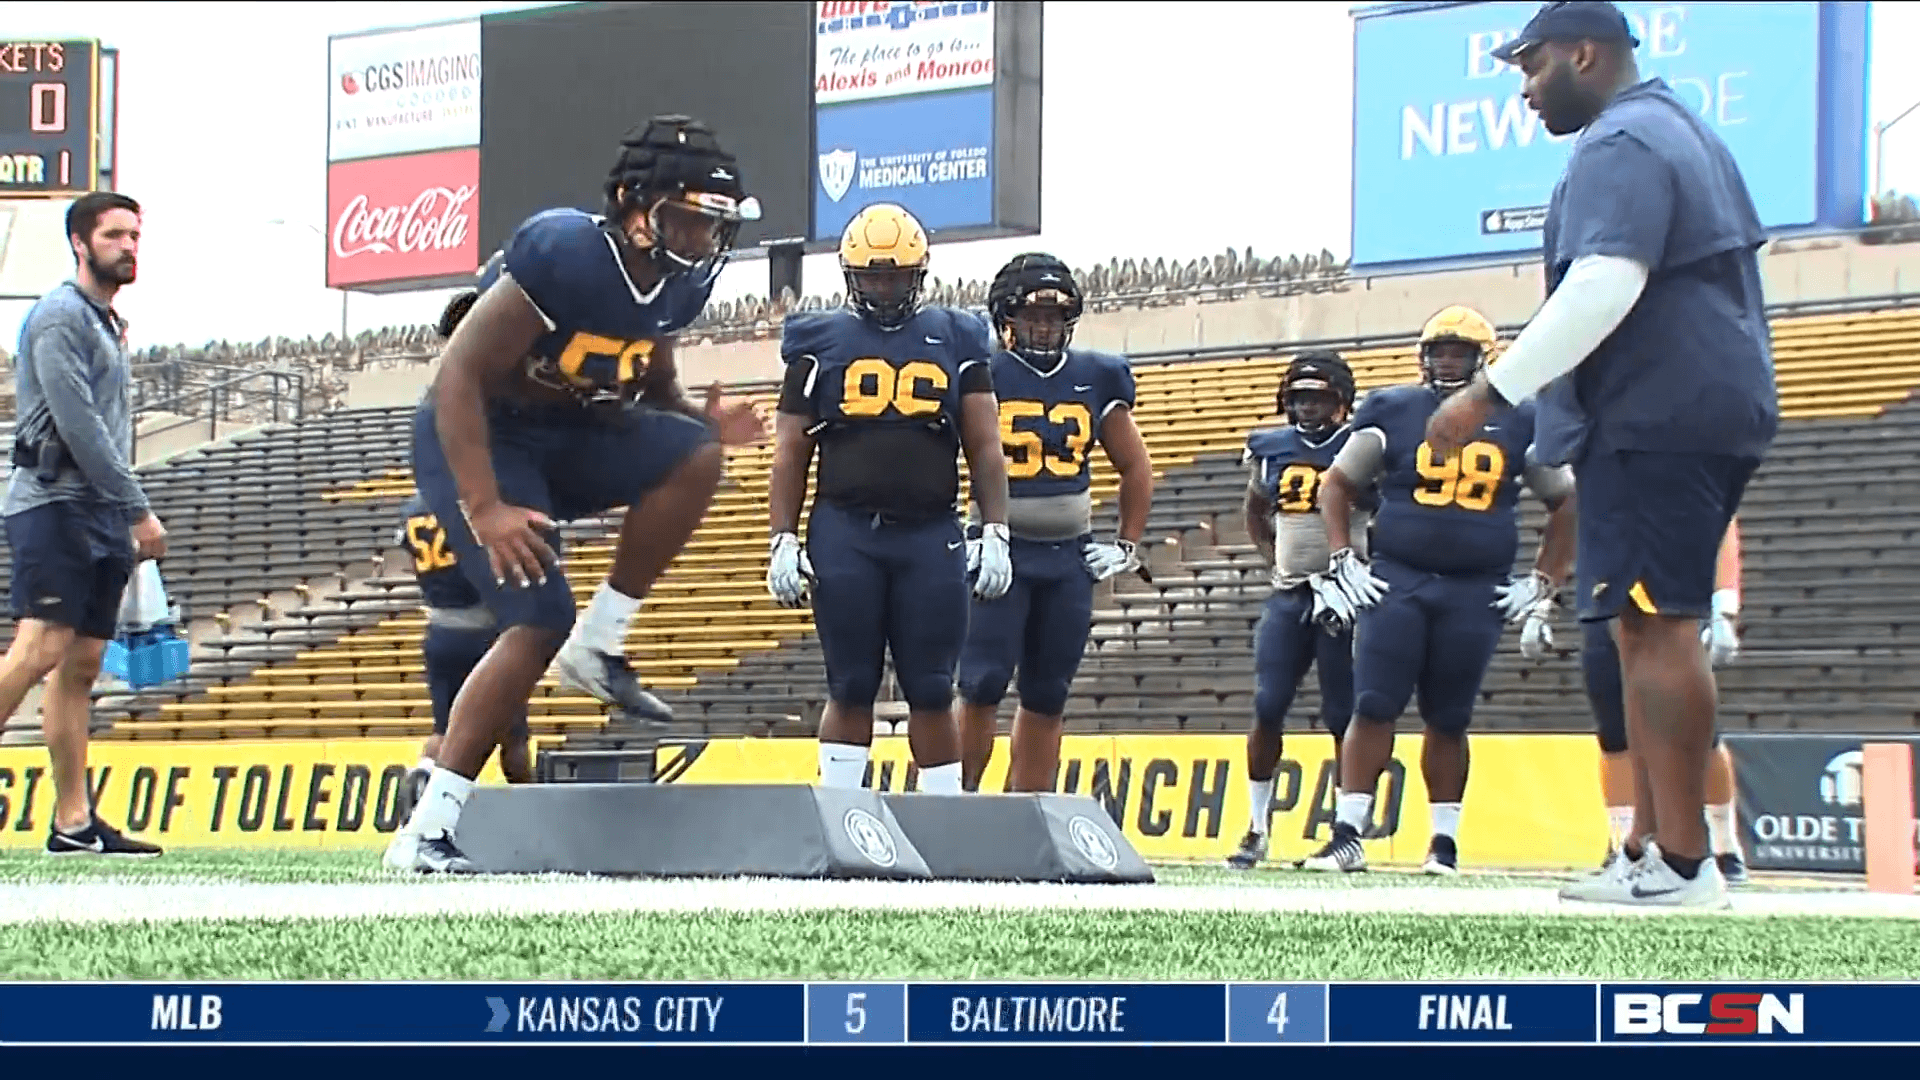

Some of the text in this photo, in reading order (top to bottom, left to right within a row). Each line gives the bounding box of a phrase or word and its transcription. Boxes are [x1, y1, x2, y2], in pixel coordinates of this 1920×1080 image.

[830, 46, 856, 67] The
[860, 44, 901, 68] place
[906, 42, 921, 58] to
[927, 40, 944, 60] go
[815, 68, 878, 93] Alexis
[885, 62, 911, 86] and
[31, 82, 66, 132] 0
[859, 158, 987, 189] MEDICAL CENTER
[860, 146, 988, 169] THE UNIVERSITY OF TOLEDO
[1000, 400, 1092, 479] 53
[1413, 441, 1504, 511] 98
[406, 513, 457, 574] 52
[127, 766, 191, 833] OF
[211, 763, 406, 833] TOLEDO
[1754, 815, 1864, 843] OLDE T
